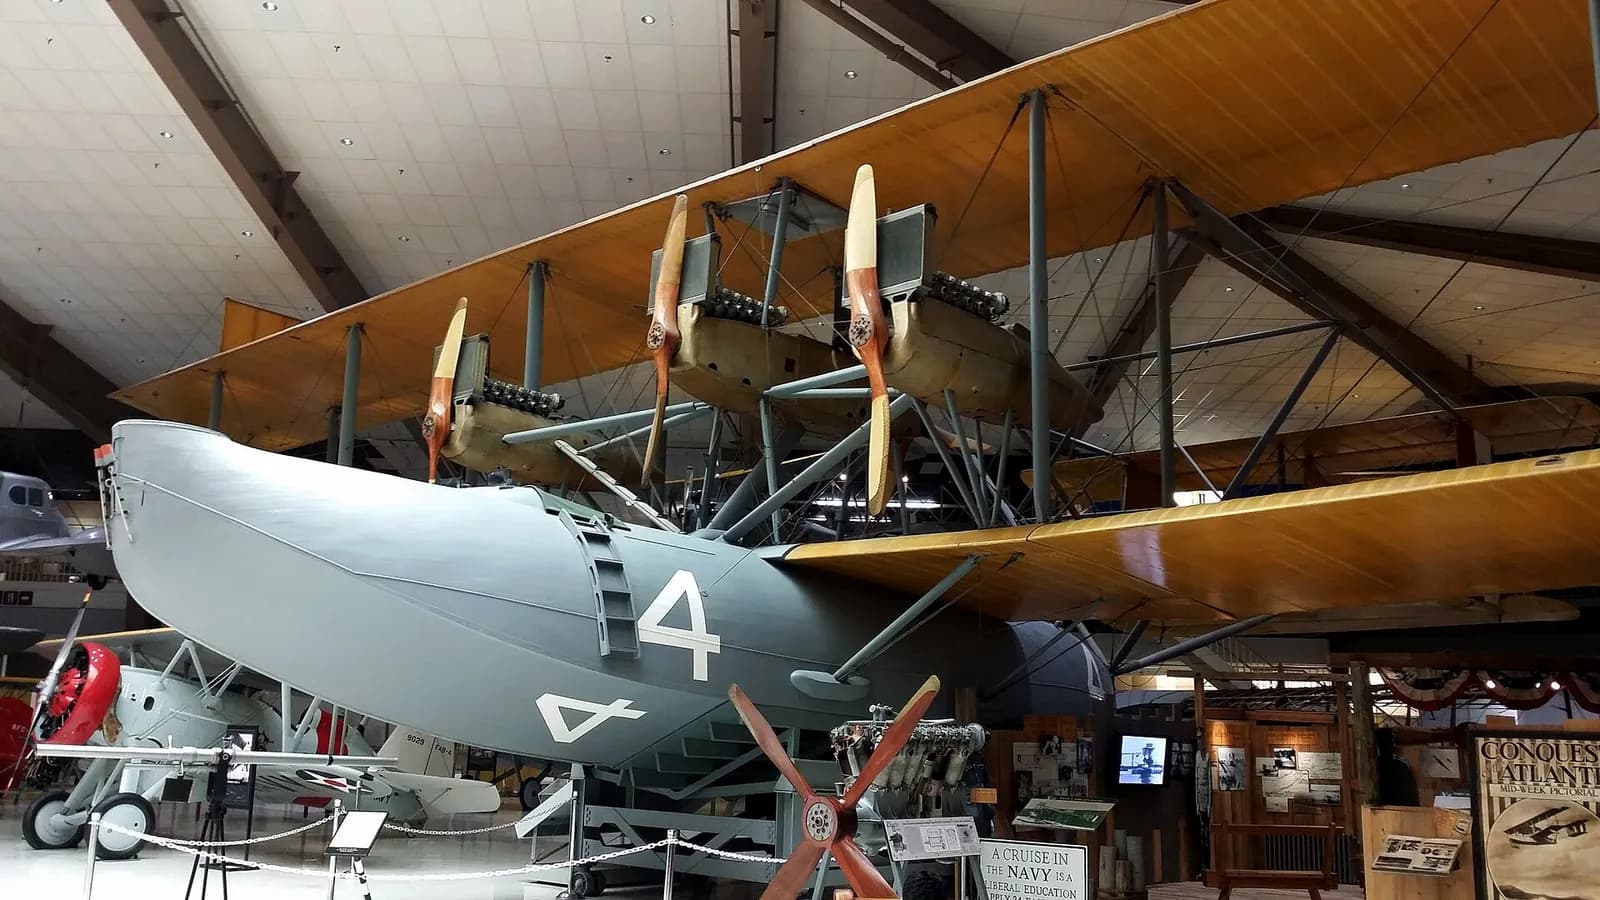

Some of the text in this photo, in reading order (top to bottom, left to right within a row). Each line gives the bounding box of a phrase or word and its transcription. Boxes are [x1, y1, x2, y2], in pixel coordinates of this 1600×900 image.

[637, 569, 721, 682] 4
[535, 693, 648, 743] 4
[407, 734, 425, 746] 9029
[1481, 741, 1600, 763] CONQUES
[1500, 784, 1598, 798] MID-WEEK PICTORIAL
[992, 848, 1069, 865] A CRUISE IN
[986, 865, 1073, 882] THE NAVY IS A
[985, 880, 1077, 899] LIBERAL EDUCATION
